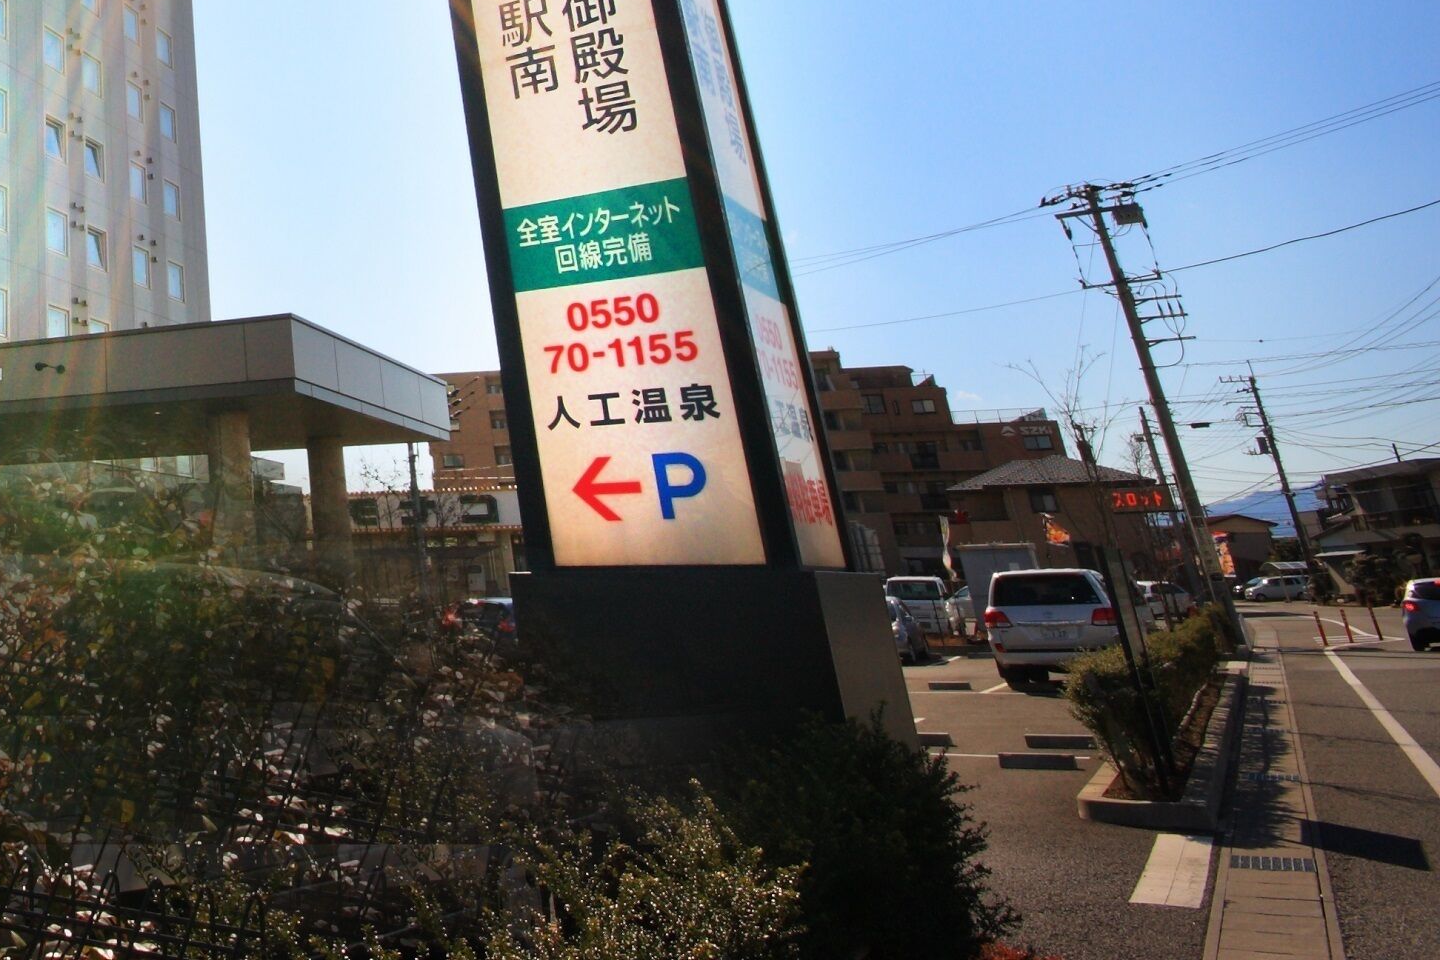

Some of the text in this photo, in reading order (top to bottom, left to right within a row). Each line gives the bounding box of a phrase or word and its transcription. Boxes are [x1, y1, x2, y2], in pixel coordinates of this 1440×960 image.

[517, 195, 681, 248] 全室インターネット
[554, 232, 653, 274] 回線完備
[565, 292, 660, 331] 0550
[543, 330, 699, 375] 70-1155
[547, 383, 722, 431] 人工温泉
[651, 452, 707, 520] P
